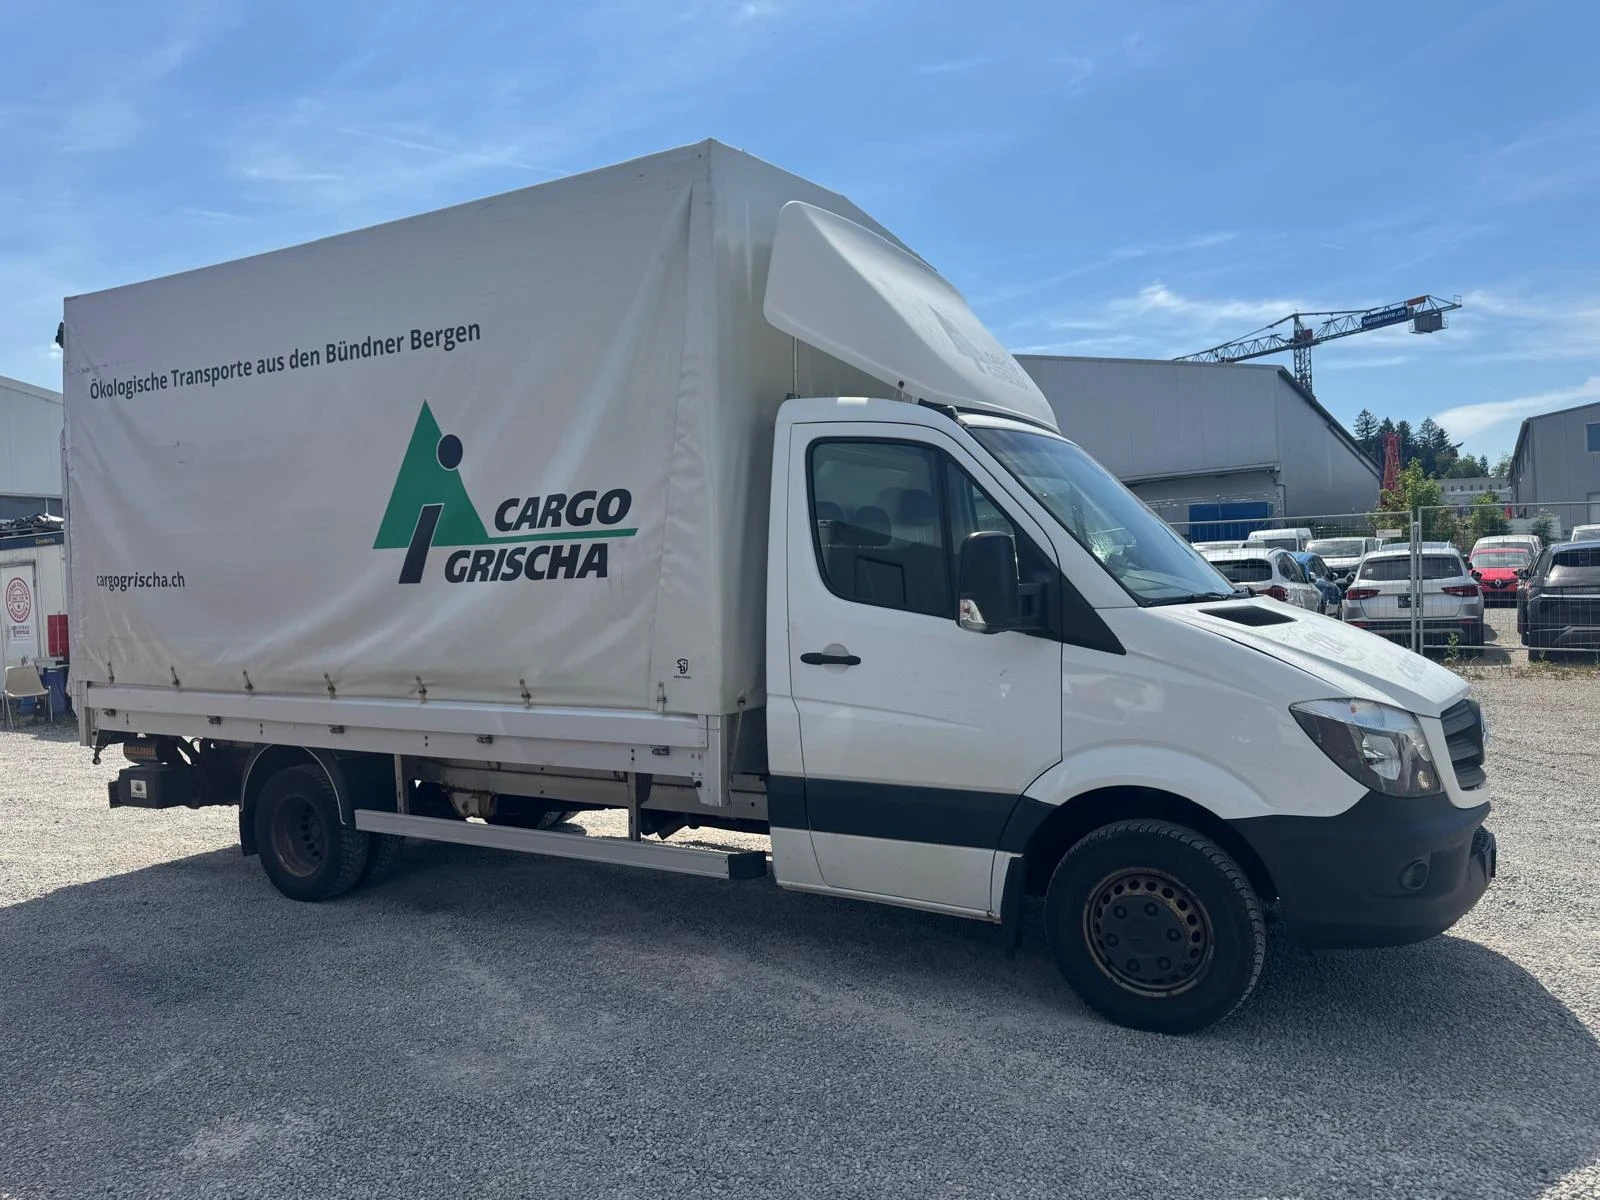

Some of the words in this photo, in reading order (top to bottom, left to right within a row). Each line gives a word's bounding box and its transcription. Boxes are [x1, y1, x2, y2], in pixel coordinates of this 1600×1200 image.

[90, 372, 168, 400] Ökologische
[171, 359, 252, 387] Transporte
[256, 355, 285, 375] aus
[289, 348, 320, 369] den
[326, 335, 404, 364] Bündner
[410, 322, 481, 351] Bergen
[494, 488, 632, 532] CARGO
[96, 571, 185, 592] cargogrischa.ch
[444, 542, 608, 584] GRISCHA
